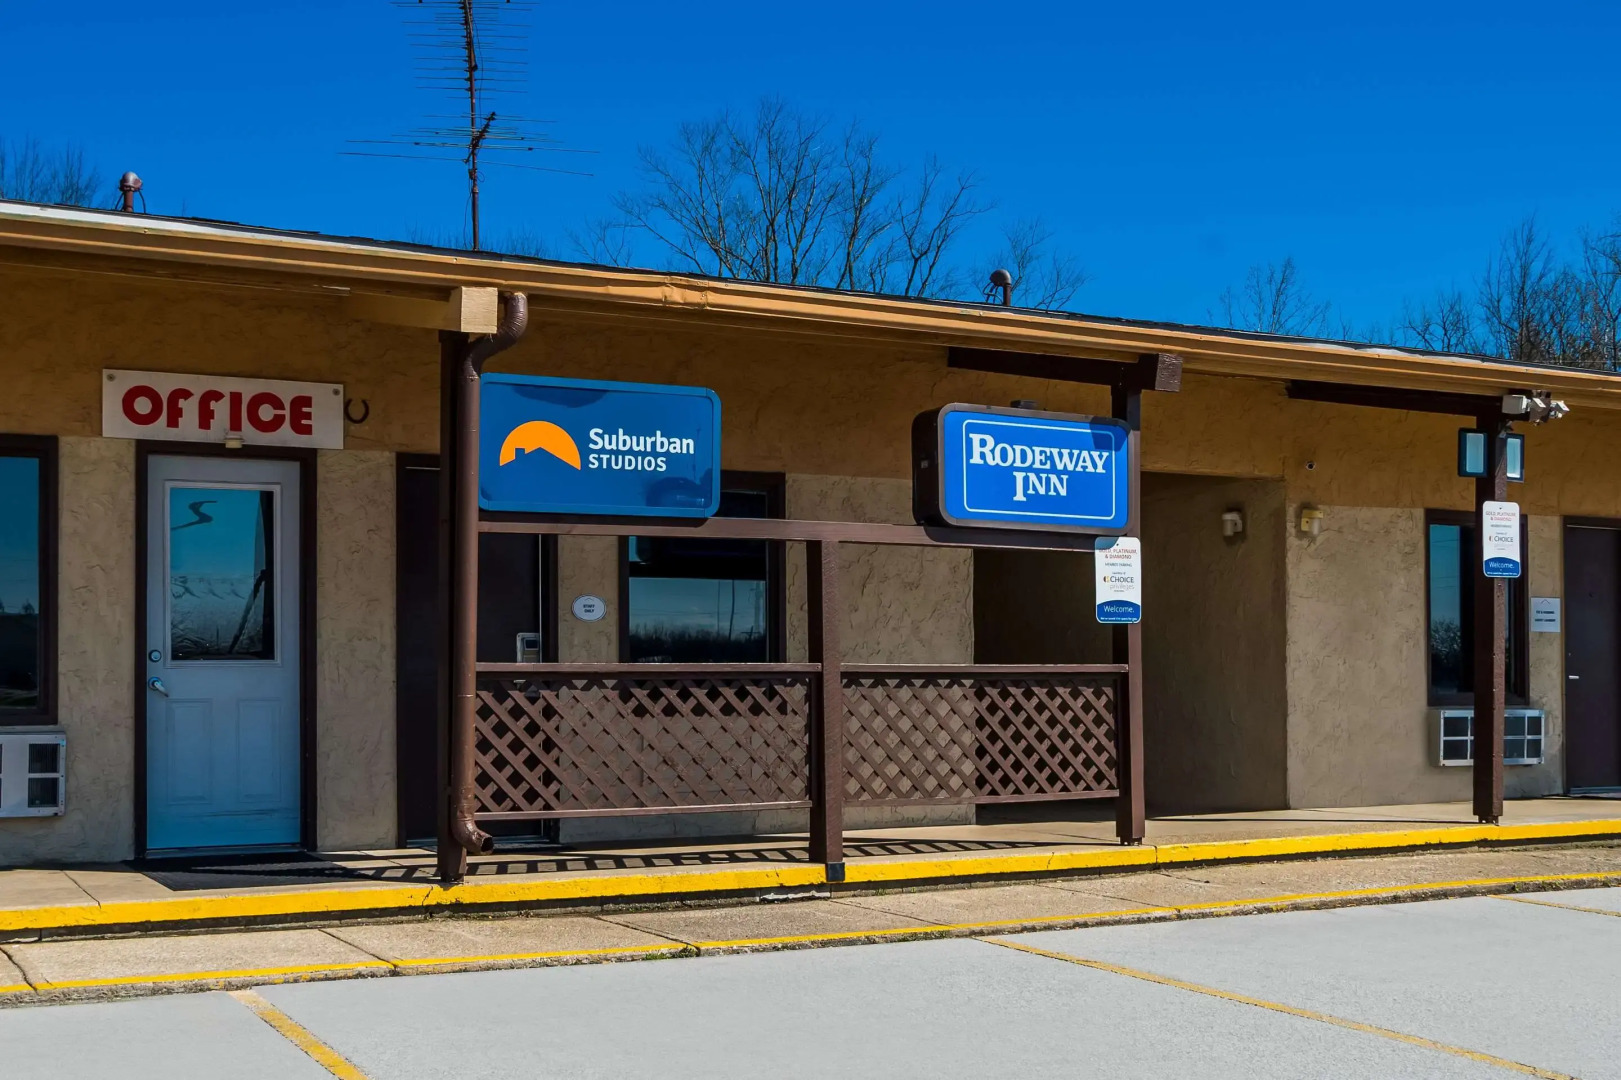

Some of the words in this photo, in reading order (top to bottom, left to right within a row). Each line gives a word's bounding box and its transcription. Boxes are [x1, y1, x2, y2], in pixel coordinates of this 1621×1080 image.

[122, 385, 313, 436] OFFICE
[588, 428, 695, 455] Suburban
[969, 433, 1109, 473] RODEWAY
[588, 454, 667, 472] STUDIOS
[1013, 471, 1068, 501] INN
[1494, 535, 1514, 543] CHOICE
